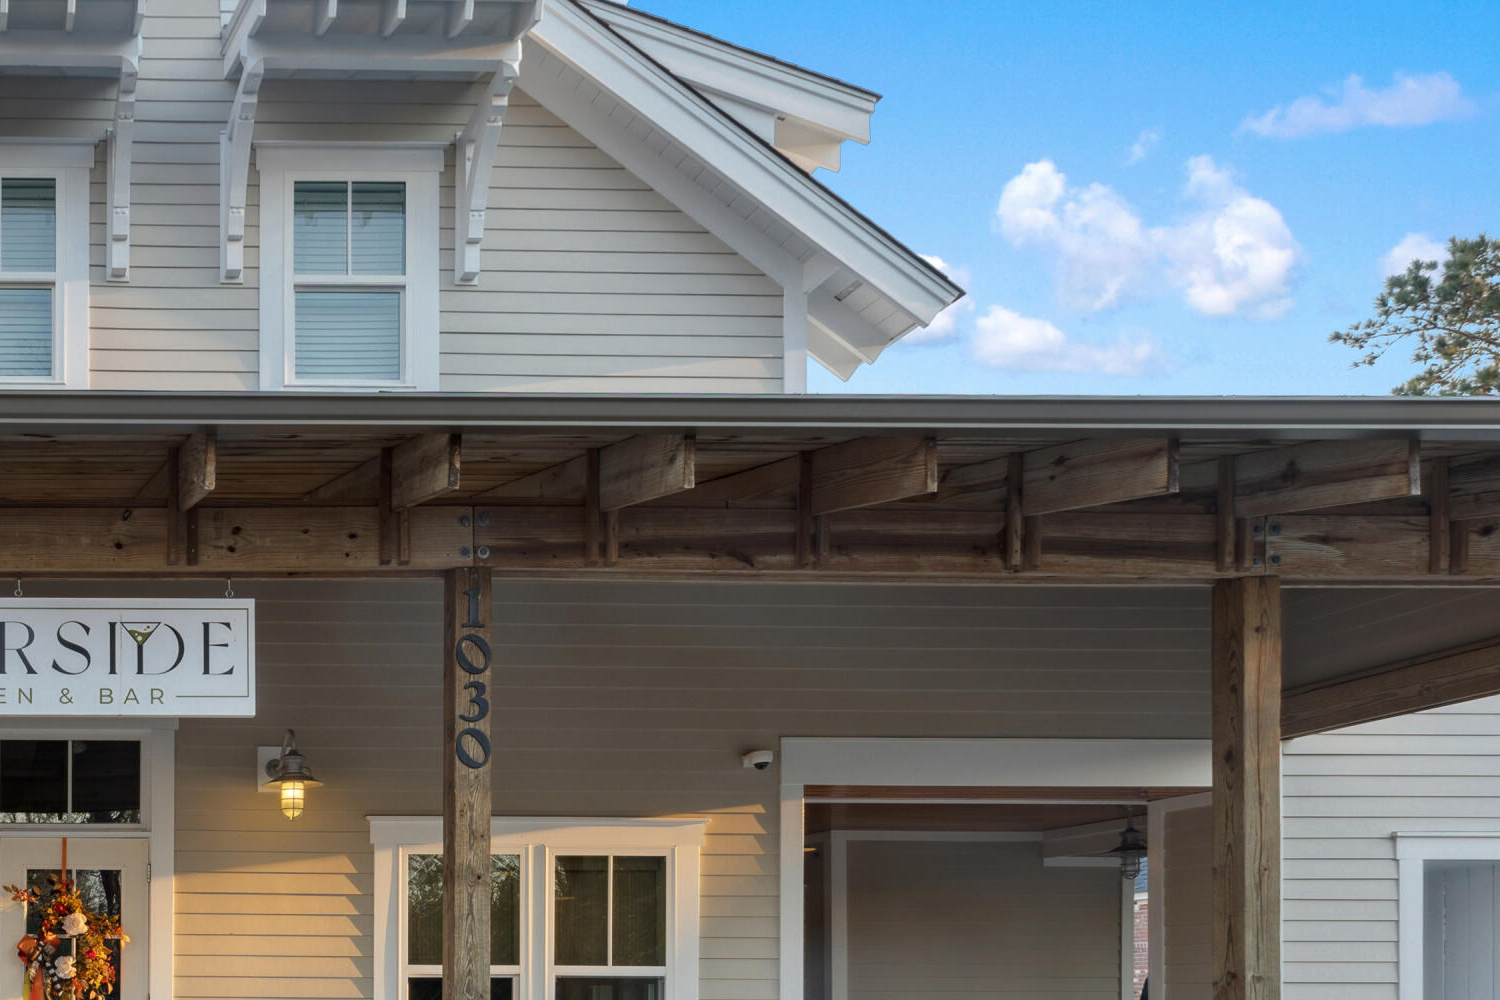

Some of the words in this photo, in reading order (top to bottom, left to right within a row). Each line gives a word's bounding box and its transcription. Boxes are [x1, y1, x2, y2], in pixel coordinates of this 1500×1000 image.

[59, 687, 75, 705] &
[100, 688, 166, 705] BAR
[456, 588, 491, 769] 1030
